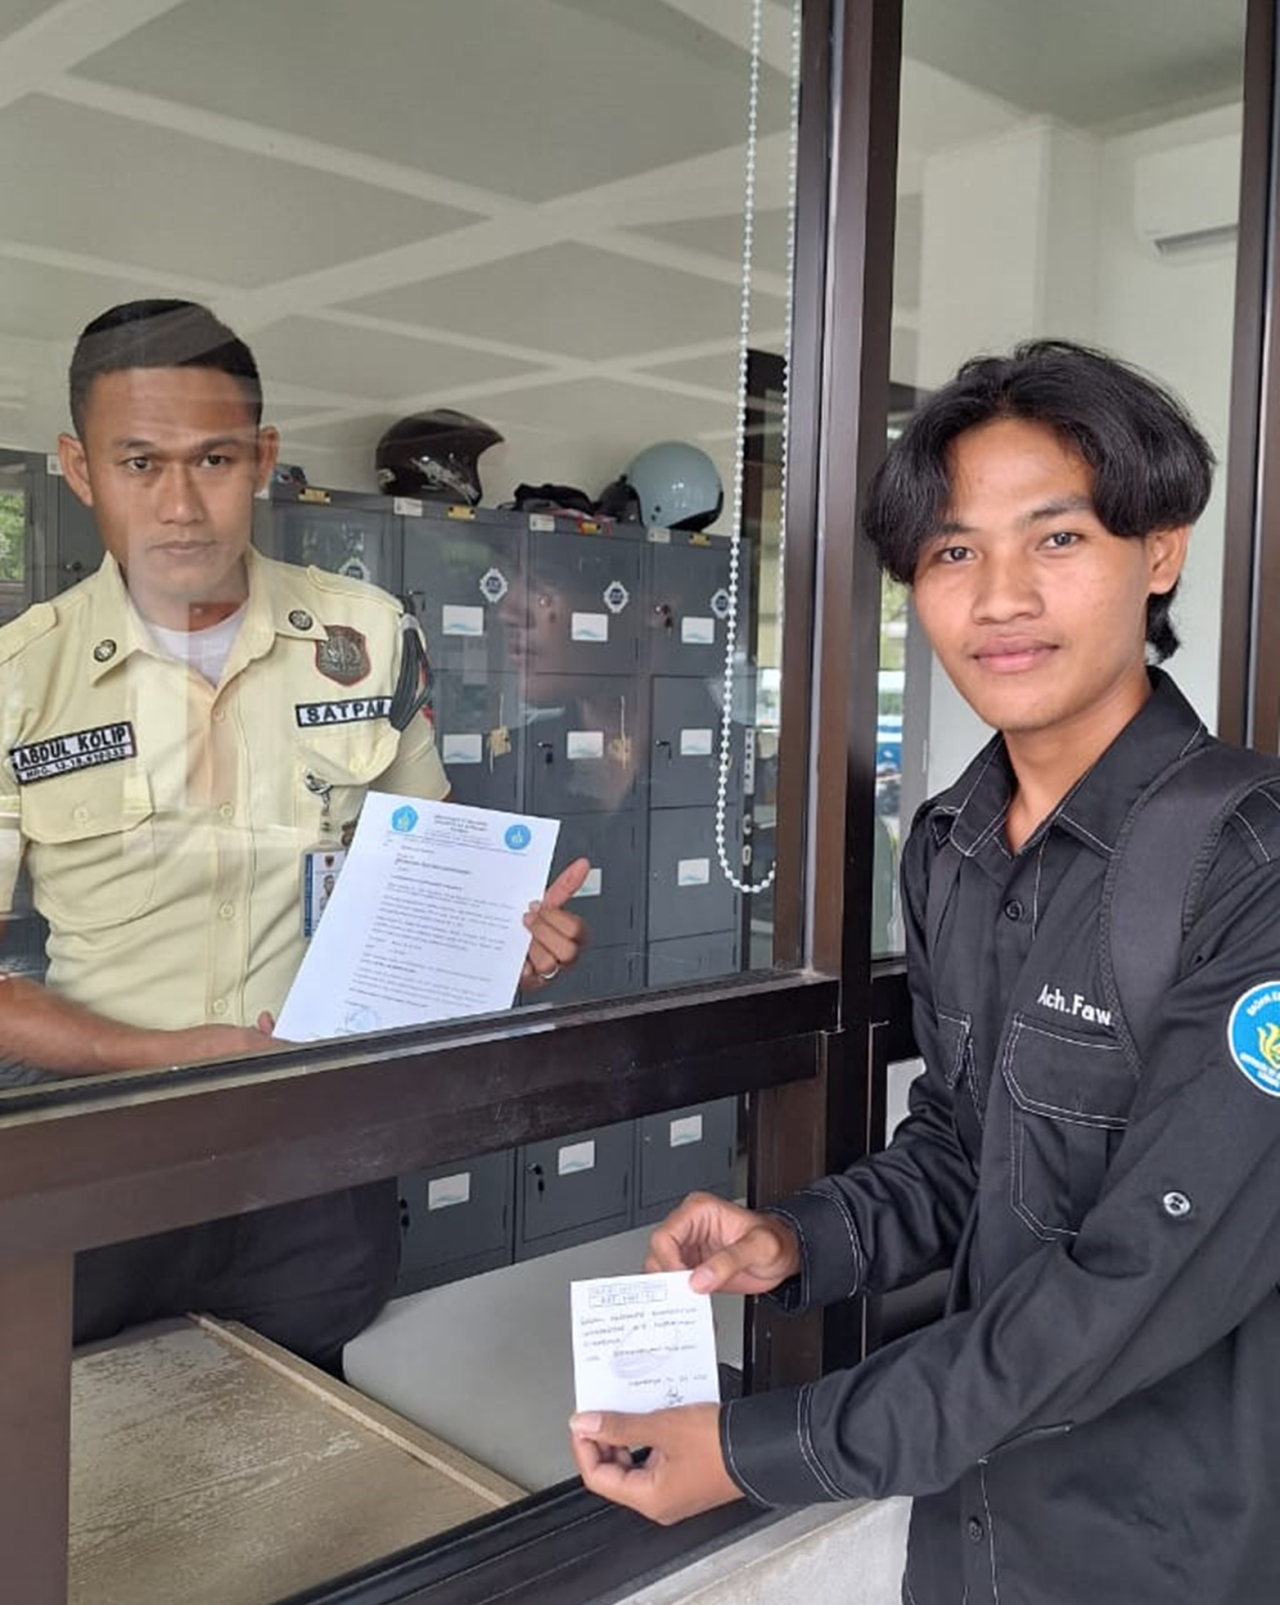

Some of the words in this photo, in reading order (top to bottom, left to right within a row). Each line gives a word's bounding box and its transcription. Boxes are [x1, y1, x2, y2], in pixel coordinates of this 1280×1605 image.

[307, 700, 384, 722] SATPAM
[19, 741, 71, 767] ABDUL
[77, 725, 126, 751] KOLIP
